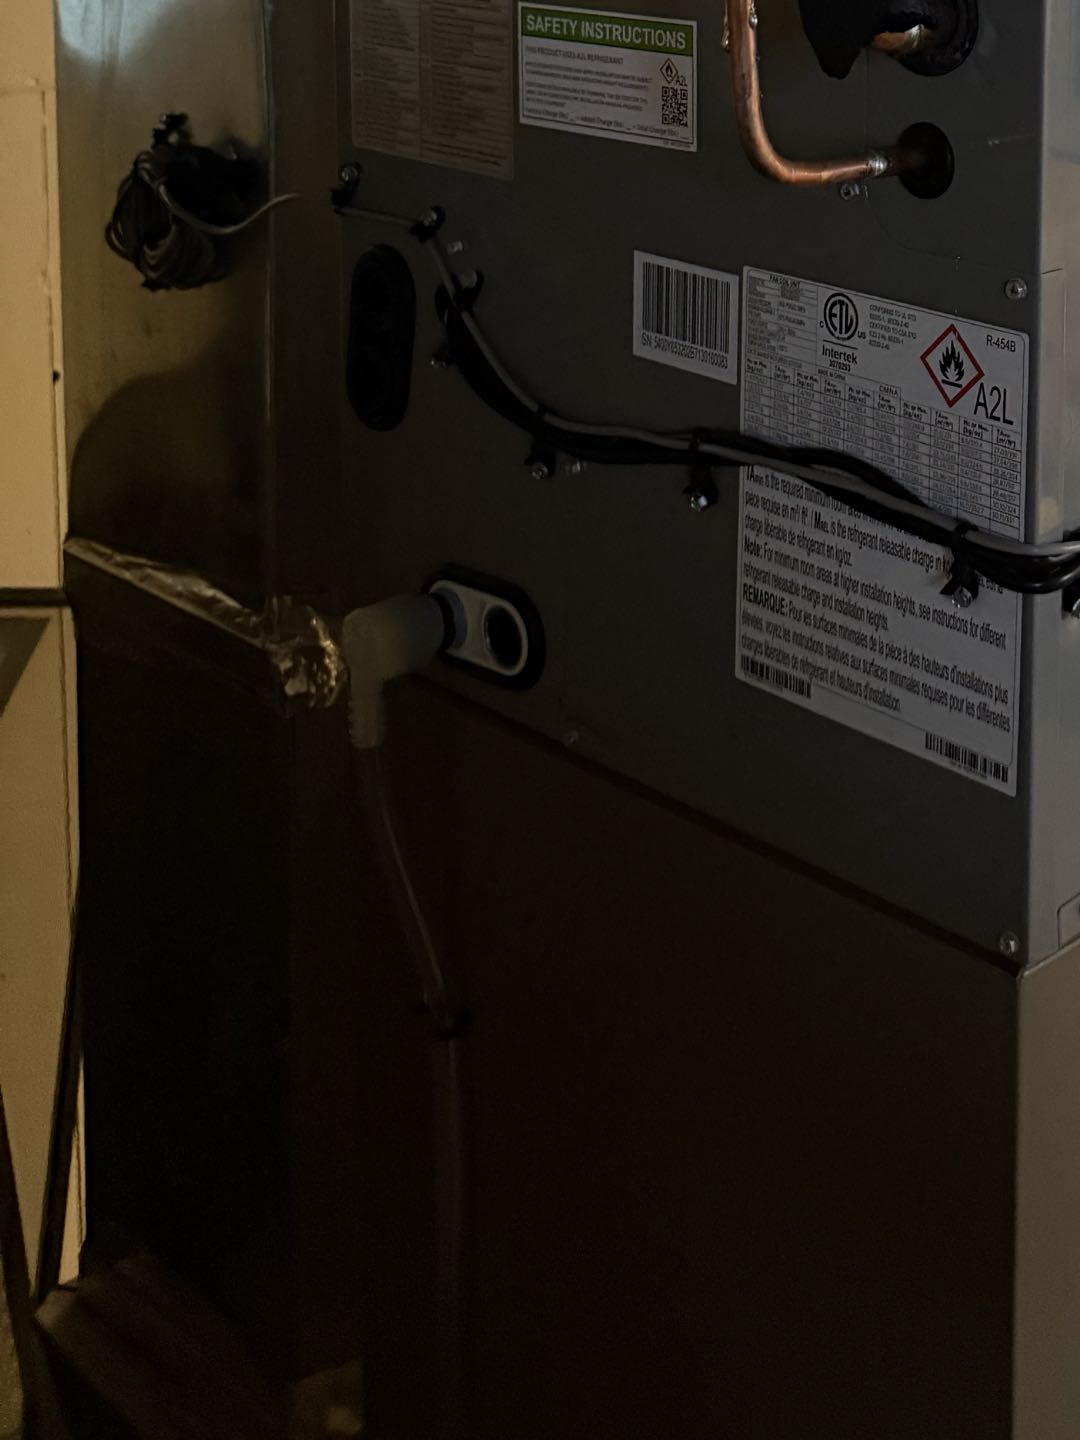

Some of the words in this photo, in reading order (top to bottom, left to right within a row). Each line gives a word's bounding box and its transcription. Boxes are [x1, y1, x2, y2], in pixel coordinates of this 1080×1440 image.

[525, 12, 578, 37] SAFETY
[580, 19, 686, 50] INSTRUCTIONS
[822, 344, 858, 365] Intertek
[857, 330, 866, 339] US
[986, 335, 1016, 352] R-454B
[974, 383, 1014, 425] A2L
[878, 534, 911, 561] releasable
[911, 545, 934, 574] charge
[743, 535, 763, 558] Note:
[762, 542, 773, 562] For
[773, 549, 799, 572] minimum
[799, 559, 816, 578] room
[815, 565, 832, 585] areas
[839, 571, 859, 599] higher
[859, 579, 892, 606] installation
[918, 602, 931, 621] see
[931, 603, 968, 635] instructions
[968, 616, 979, 639] for
[978, 620, 1007, 650] different
[800, 581, 821, 610] charge
[821, 589, 834, 610] and
[833, 592, 865, 622] installation
[741, 582, 788, 617] REMARQUE:
[787, 600, 803, 623] Pour
[802, 608, 812, 626] les
[812, 611, 838, 636] surfaces
[837, 621, 868, 648] minimales
[868, 632, 877, 653] de
[877, 635, 884, 655] la
[908, 647, 920, 669] des
[920, 652, 950, 681] hauteurs
[993, 680, 1009, 708] plus
[782, 625, 791, 642] les
[849, 653, 861, 671] aux
[861, 654, 888, 683] surfaces
[888, 665, 920, 696] minimales
[920, 682, 948, 709] requises
[949, 693, 965, 717] pour
[965, 697, 975, 718] les
[836, 669, 861, 697] hauteurs
